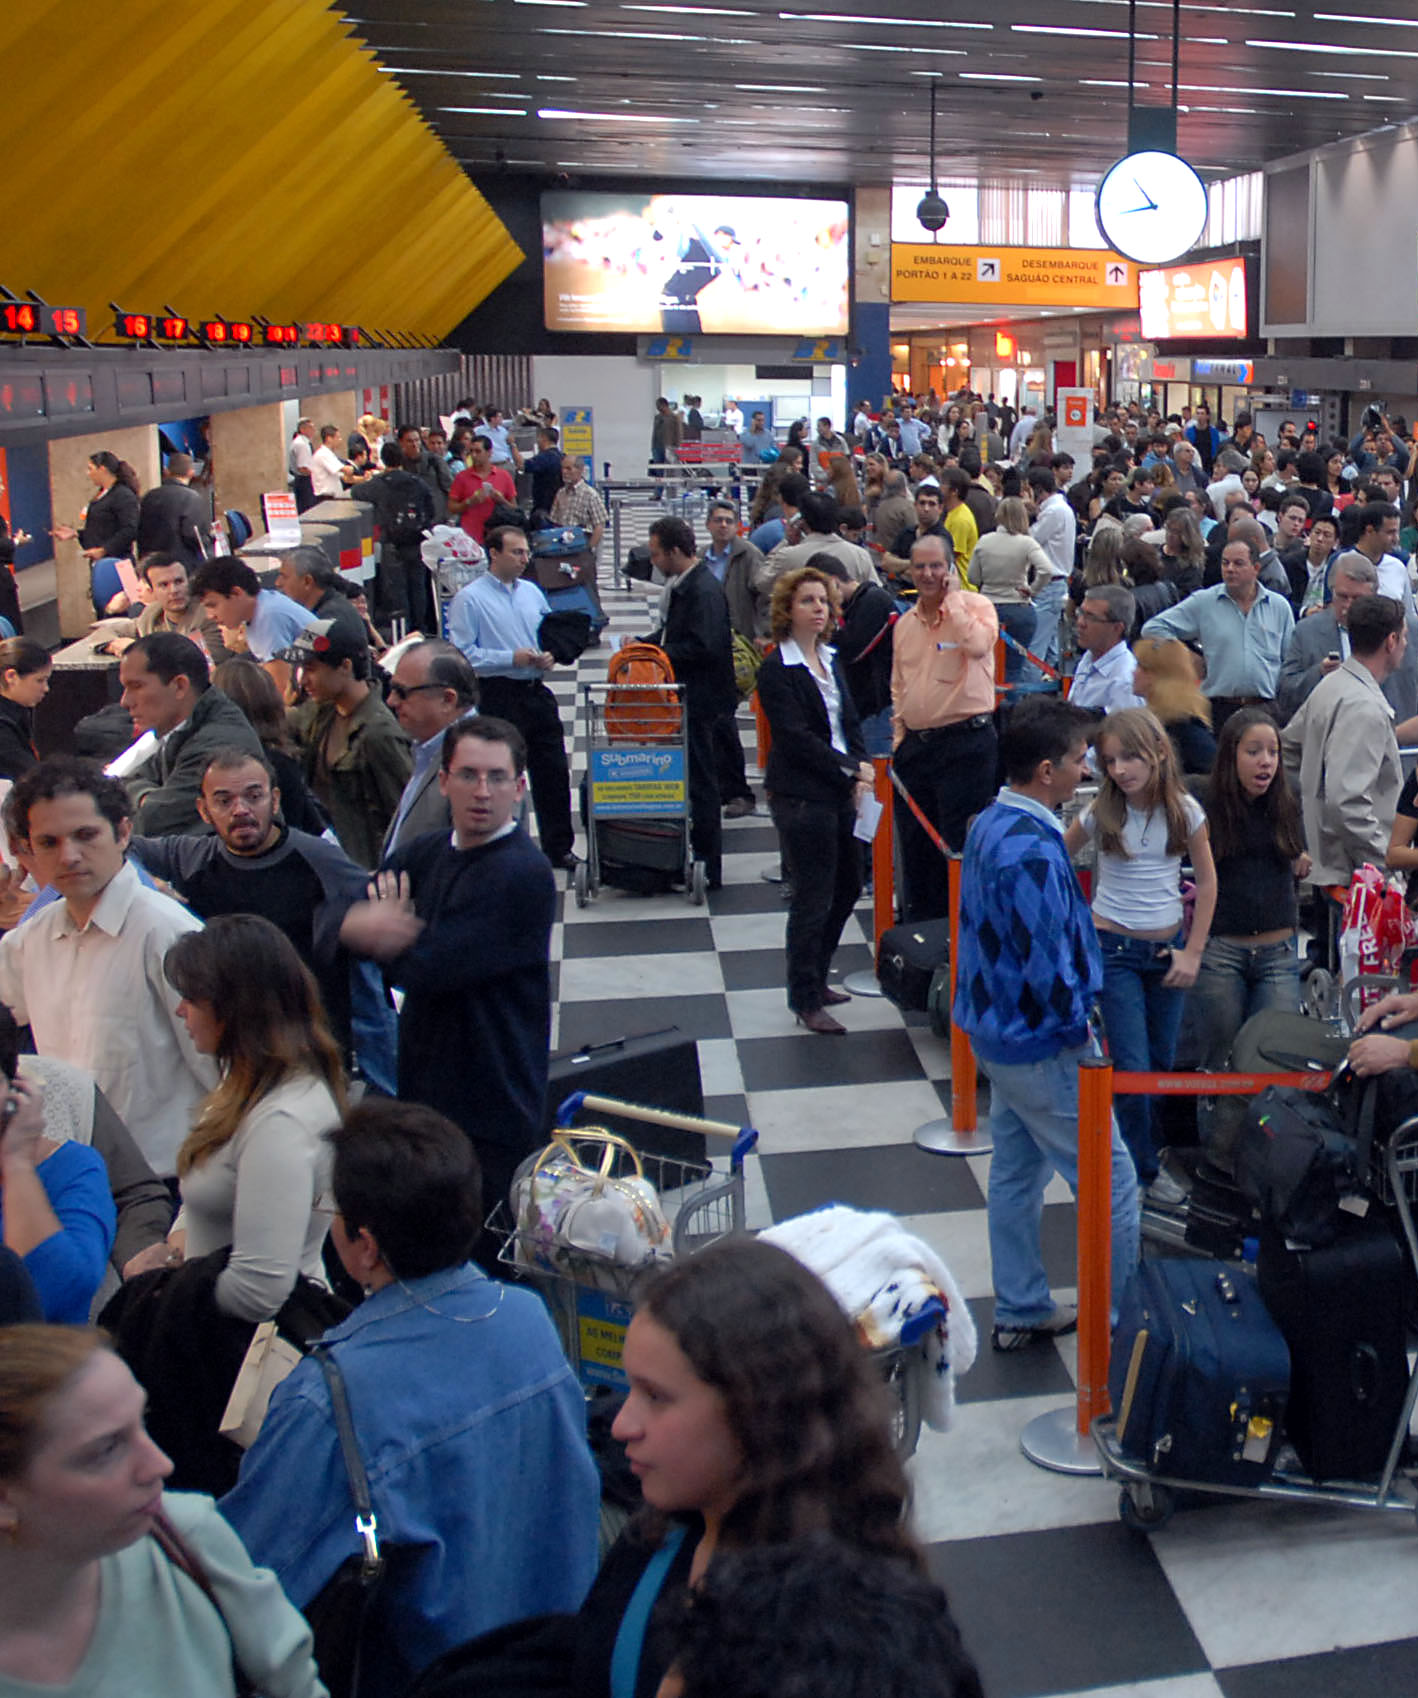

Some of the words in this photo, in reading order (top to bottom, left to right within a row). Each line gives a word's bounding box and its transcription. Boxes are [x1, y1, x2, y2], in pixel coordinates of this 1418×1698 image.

[913, 255, 973, 266] EMBARQUE
[1022, 259, 1099, 271] DESEMBARQUE
[896, 269, 940, 280] PORTÃO
[960, 272, 973, 281] 22
[1006, 272, 1050, 283] SAGUÃO
[1052, 274, 1099, 285] CENTRAL
[4, 304, 34, 331] 14
[52, 309, 79, 334] 15
[124, 315, 149, 337] 16
[163, 318, 186, 338] 17
[601, 752, 673, 767] Submarino
